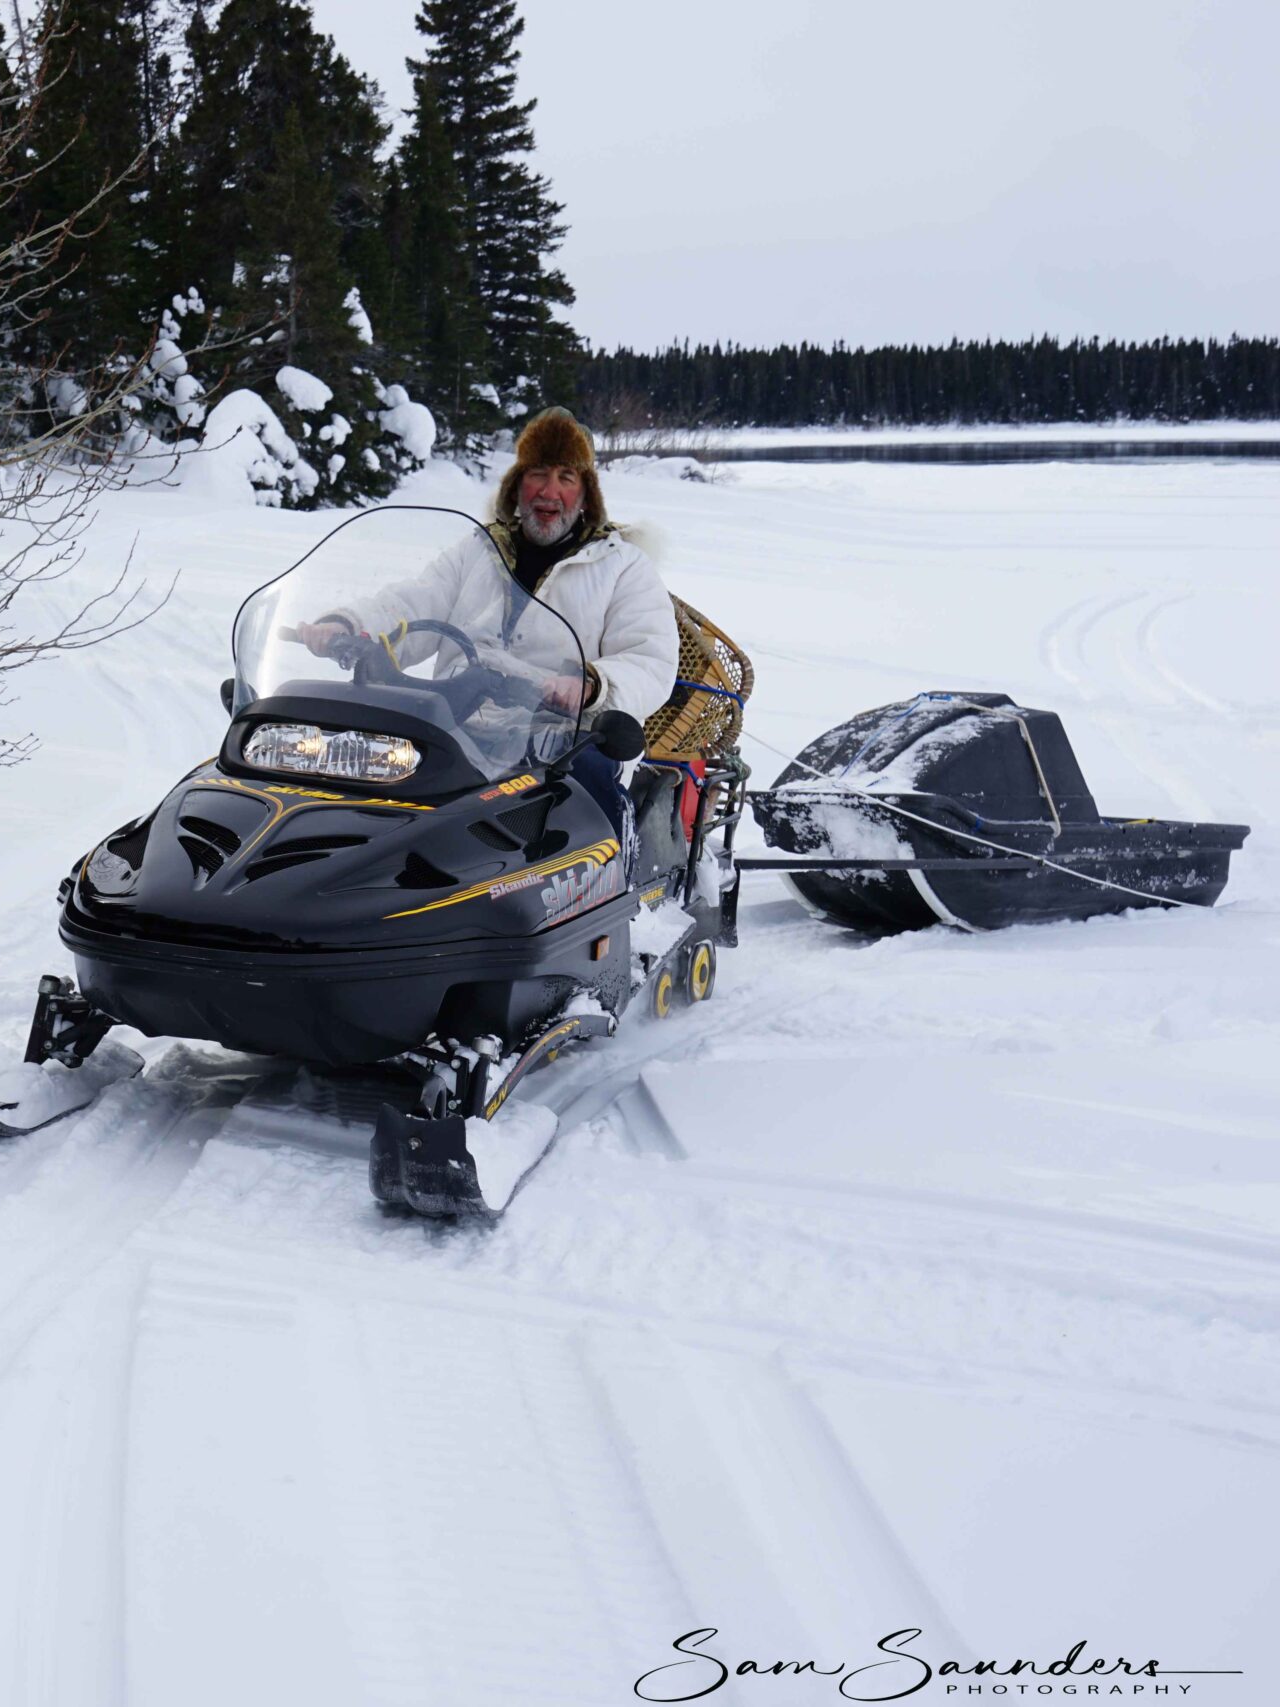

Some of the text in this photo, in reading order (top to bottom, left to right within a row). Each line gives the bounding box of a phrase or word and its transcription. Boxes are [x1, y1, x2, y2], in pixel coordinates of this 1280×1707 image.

[498, 774, 538, 796] 600
[489, 873, 544, 900] Skandic
[541, 860, 618, 924] ski-doo
